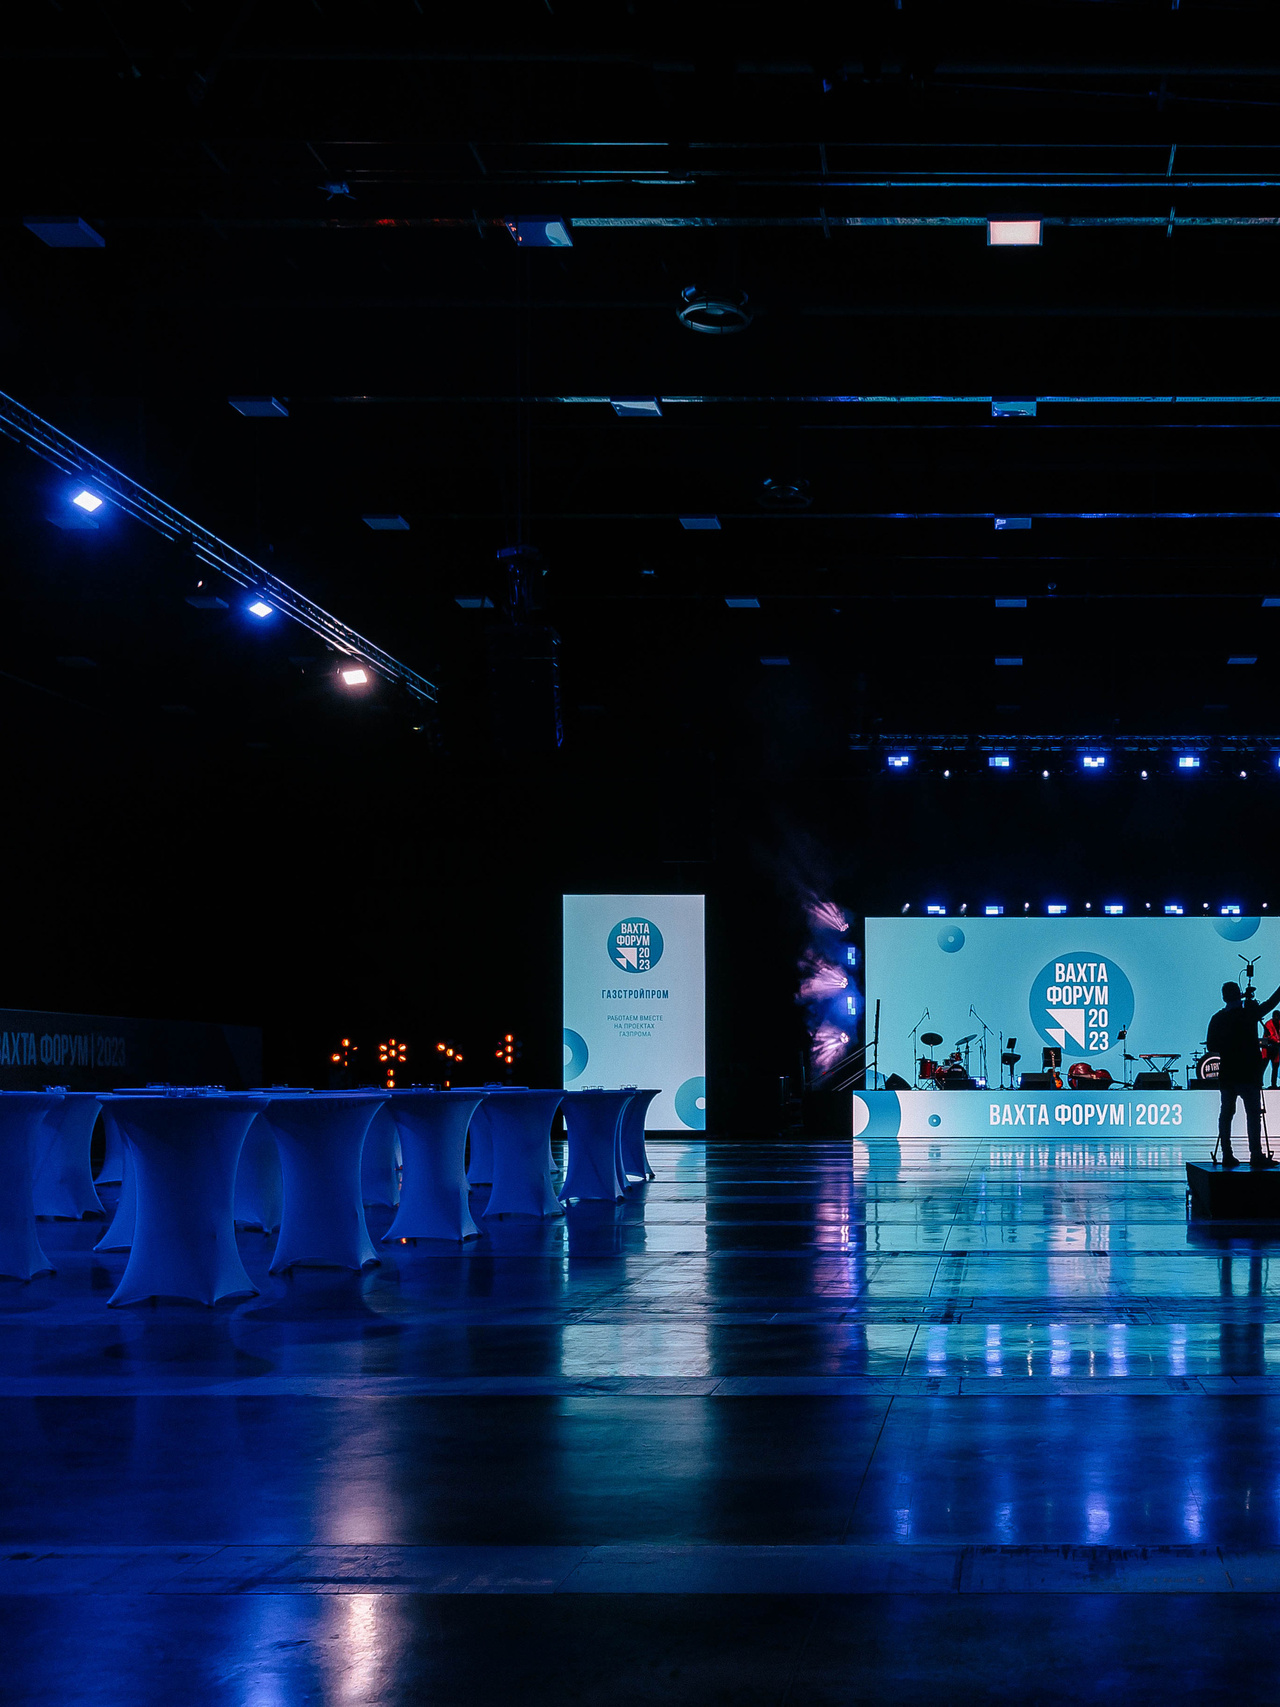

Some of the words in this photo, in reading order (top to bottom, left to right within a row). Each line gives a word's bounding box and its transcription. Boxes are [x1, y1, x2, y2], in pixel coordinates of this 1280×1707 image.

[621, 923, 650, 934] ВАХТА
[616, 935, 650, 946] ФОРУМ
[638, 947, 650, 958] 20
[639, 959, 650, 970] 23
[1055, 963, 1108, 983] ВАХТА
[601, 988, 669, 999] ГАЗСТРОЙПРОМ
[1046, 985, 1108, 1005] ФОРУМ
[1088, 1008, 1108, 1028] 20
[0, 1031, 37, 1066] АХТА
[40, 1033, 89, 1066] ФОРУМ
[96, 1035, 126, 1067] 2023
[1089, 1031, 1109, 1050] 23
[989, 1104, 1050, 1125] ВАХТА
[1054, 1103, 1125, 1125] ФОРУМ
[1136, 1104, 1183, 1125] 2023
